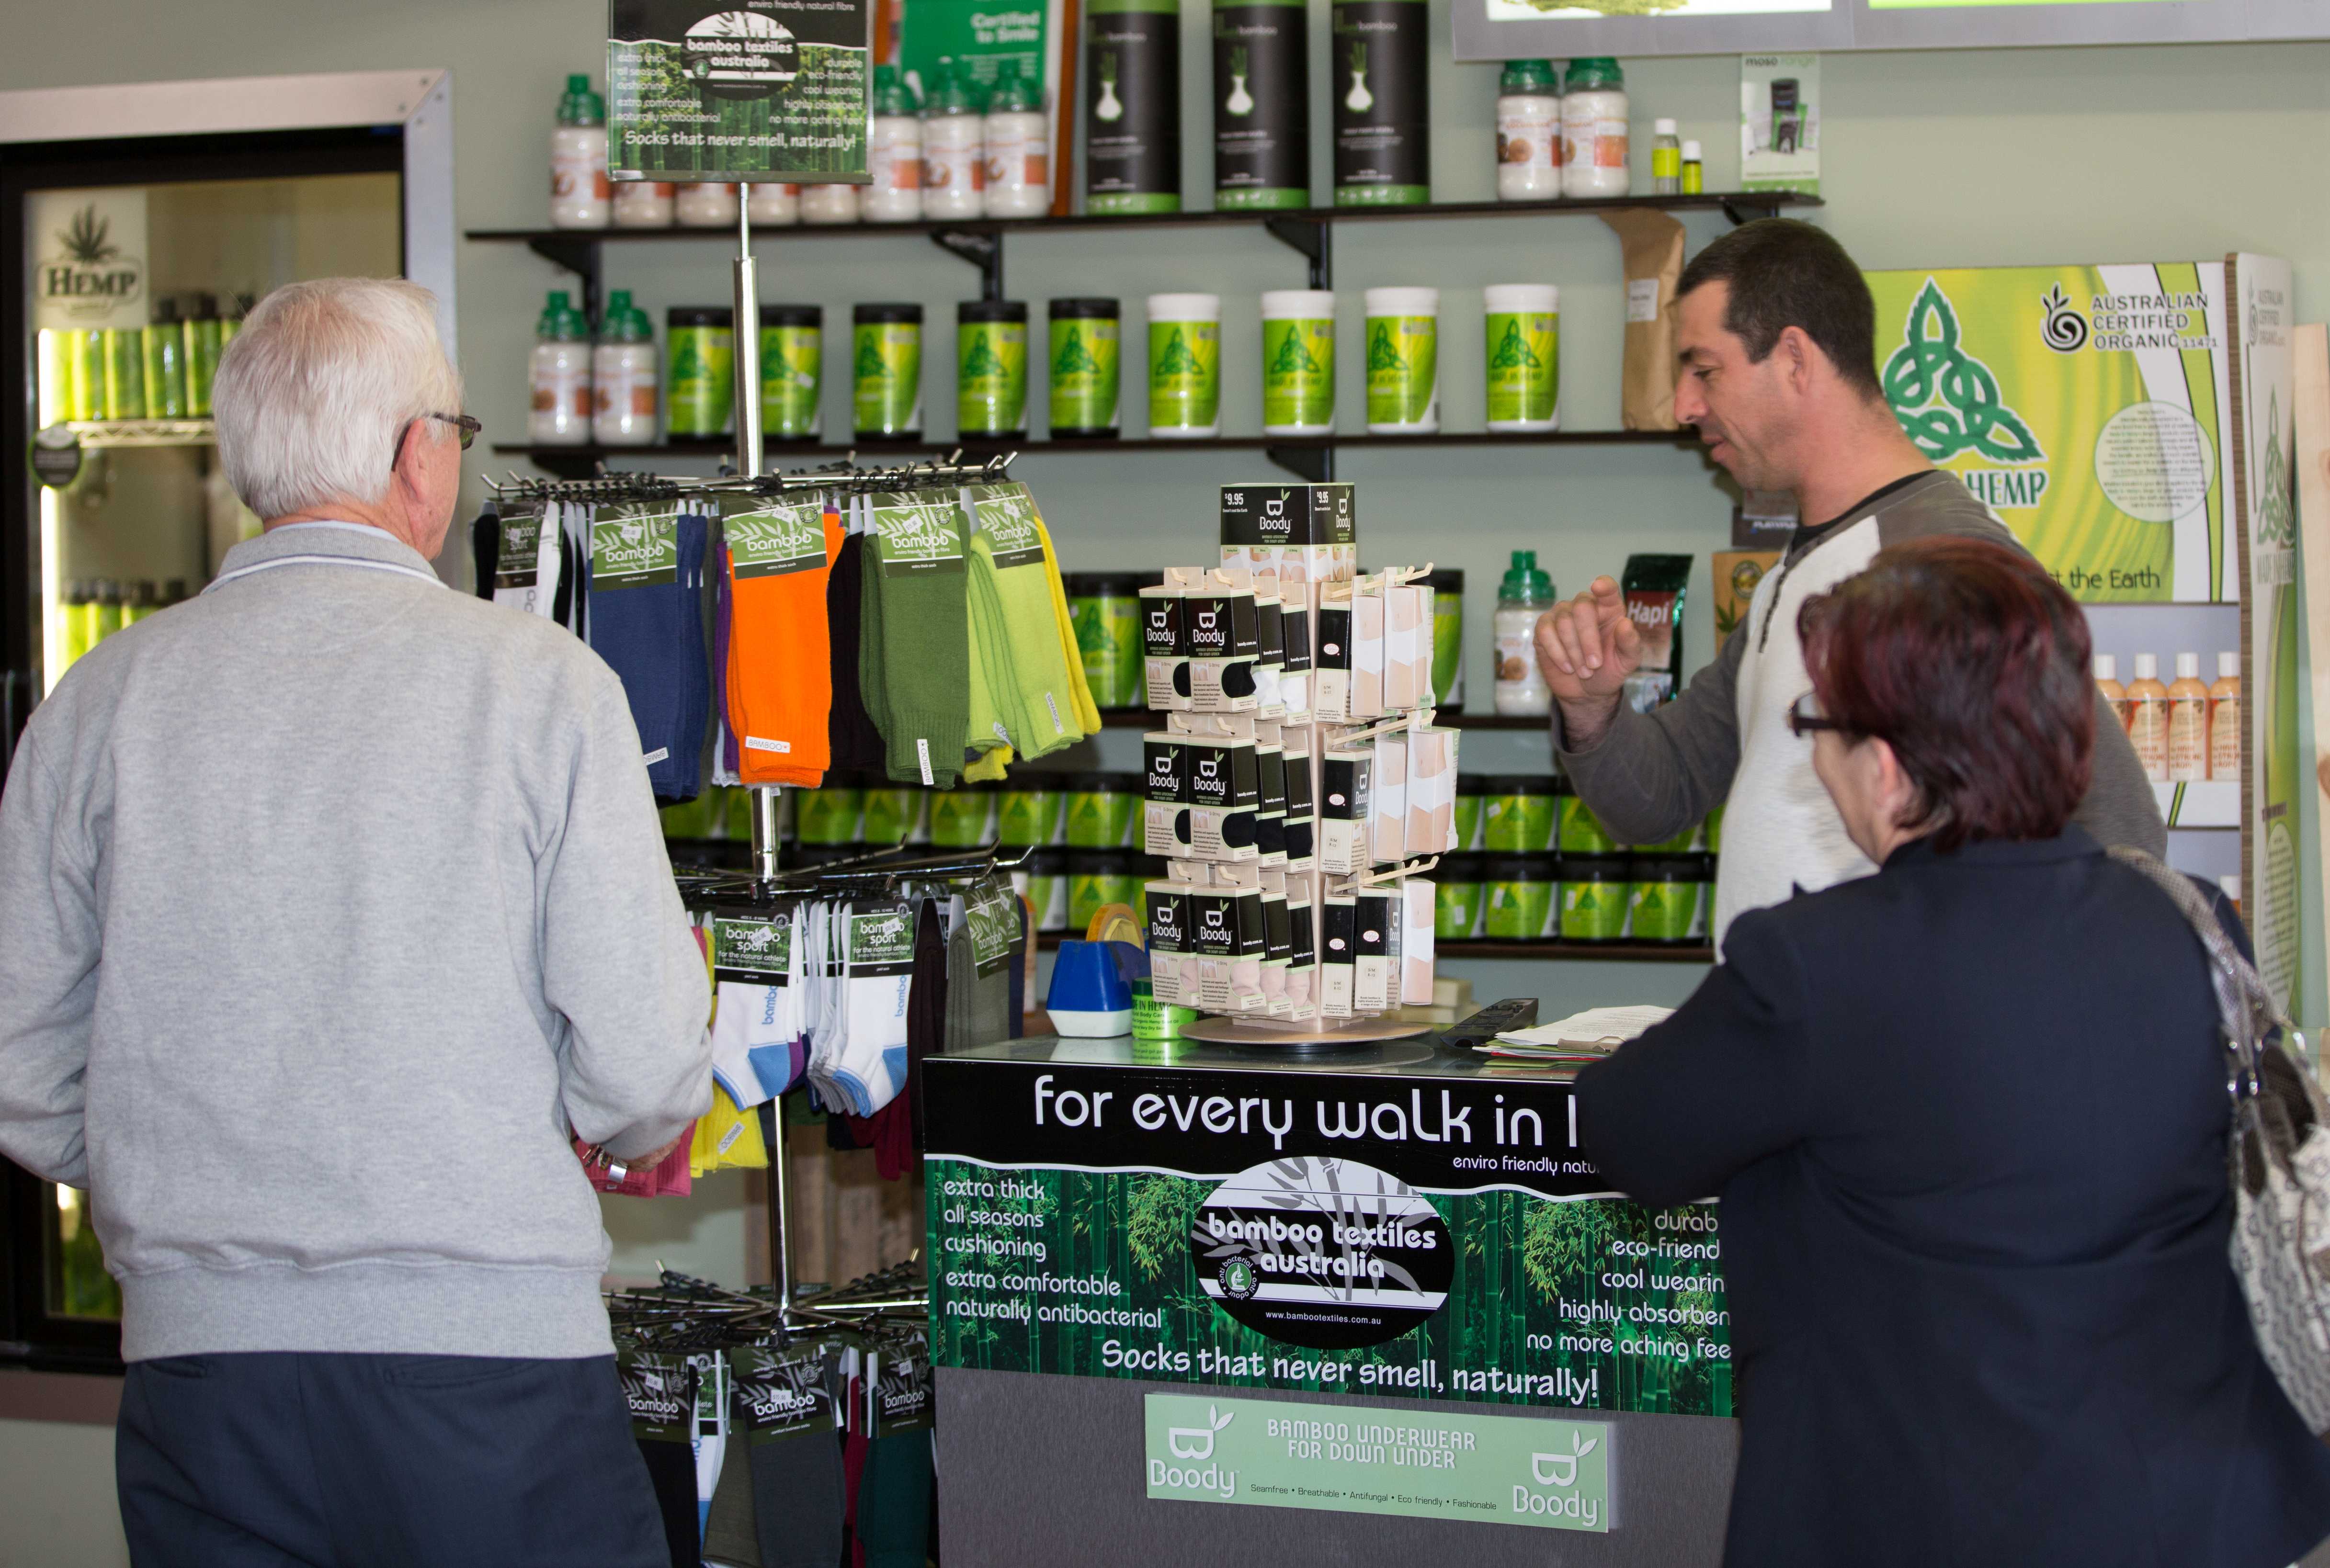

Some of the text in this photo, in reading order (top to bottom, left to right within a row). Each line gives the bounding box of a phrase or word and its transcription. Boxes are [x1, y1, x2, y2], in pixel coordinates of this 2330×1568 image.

[774, 0, 805, 11] friendly
[807, 1, 834, 10] natural
[836, 2, 855, 11] fibre
[970, 11, 1040, 29] Certified
[687, 38, 793, 54] bamboo textiles
[711, 55, 770, 68] australia
[808, 71, 863, 83] eco-friendly
[616, 81, 667, 93] cushioning
[803, 85, 863, 97] cool wearing
[616, 98, 702, 108] extra comfortable
[784, 99, 813, 111] highly
[662, 113, 721, 123] antibacterial
[769, 115, 781, 124] no
[811, 114, 841, 127] aching
[625, 130, 856, 151] Socks that never smell, naturally!
[2091, 292, 2209, 310] AUSTRALIAN
[2093, 313, 2189, 330] CERTIFIED
[2094, 332, 2219, 350] ORGANIC 11471
[1317, 491, 1329, 503] $9.95
[1966, 472, 2047, 505] HEMP
[1225, 493, 1244, 505] $9.95
[1260, 516, 1291, 533] Boody
[1336, 515, 1351, 531] Boody
[747, 534, 812, 551] bamboo
[892, 533, 948, 548] bamboo
[992, 525, 1032, 541] bamboo
[605, 545, 664, 562] bamboo
[2070, 565, 2103, 588] the
[2110, 565, 2161, 589] Earth
[1627, 599, 1670, 629] Hapi
[1147, 628, 1175, 645] Boody
[1193, 629, 1225, 646] Boody
[1047, 694, 1060, 727] BAMBOO
[749, 739, 782, 750] BAMBOO
[922, 748, 932, 783] BAMBOO
[1149, 772, 1179, 791] Boody
[1194, 776, 1225, 795] Boody
[726, 926, 781, 942] bamo
[860, 920, 905, 934] bamo
[1152, 922, 1182, 942] Boody
[1200, 926, 1231, 945] Boody
[737, 941, 768, 953] sport
[870, 933, 896, 946] sport
[978, 933, 1002, 949] bamboo
[764, 954, 786, 962] athlete
[762, 985, 778, 1025] bambo
[895, 975, 908, 1017] bambo
[1034, 1074, 1113, 1127] for
[1133, 1093, 1293, 1150] every
[1316, 1088, 1472, 1143] walk
[1495, 1094, 1542, 1146] in
[721, 1123, 742, 1149] BAMBOO
[1453, 1155, 1498, 1170] enviro
[1502, 1155, 1557, 1176] friendly
[944, 1179, 1045, 1200] extra thick
[944, 1206, 1044, 1228] all seasons
[1655, 1209, 1718, 1232] durab
[1208, 1213, 1436, 1249] bamboo textiles
[945, 1235, 1046, 1263] cushioning
[1613, 1239, 1721, 1260] eco-friend
[1221, 1255, 1254, 1268] bacterial
[1260, 1251, 1385, 1278] australia
[946, 1271, 1121, 1297] extra comfortable
[1228, 1276, 1258, 1300] anti odour
[1602, 1270, 1725, 1293] cool wearin
[946, 1299, 1161, 1329] naturally antibacterial
[1265, 1311, 1381, 1324] www.bambootextiles.com.au
[1560, 1297, 1730, 1326] highly absorben
[1526, 1333, 1732, 1363] no more aching fee
[1102, 1339, 1598, 1405] Socks that never smell, naturally!
[626, 1394, 679, 1413] bamboo
[753, 1394, 815, 1416] bamboo
[885, 1390, 924, 1408] bamboo
[1268, 1419, 1476, 1451] BAMBOO UNDERWEAR
[1288, 1440, 1456, 1470] FOR DOWN UNDER
[1149, 1459, 1237, 1499] Boody
[1250, 1484, 1497, 1511] Seamfree Breathable Antifungal Eco friendly Fashionable
[1512, 1485, 1599, 1527] Boody
